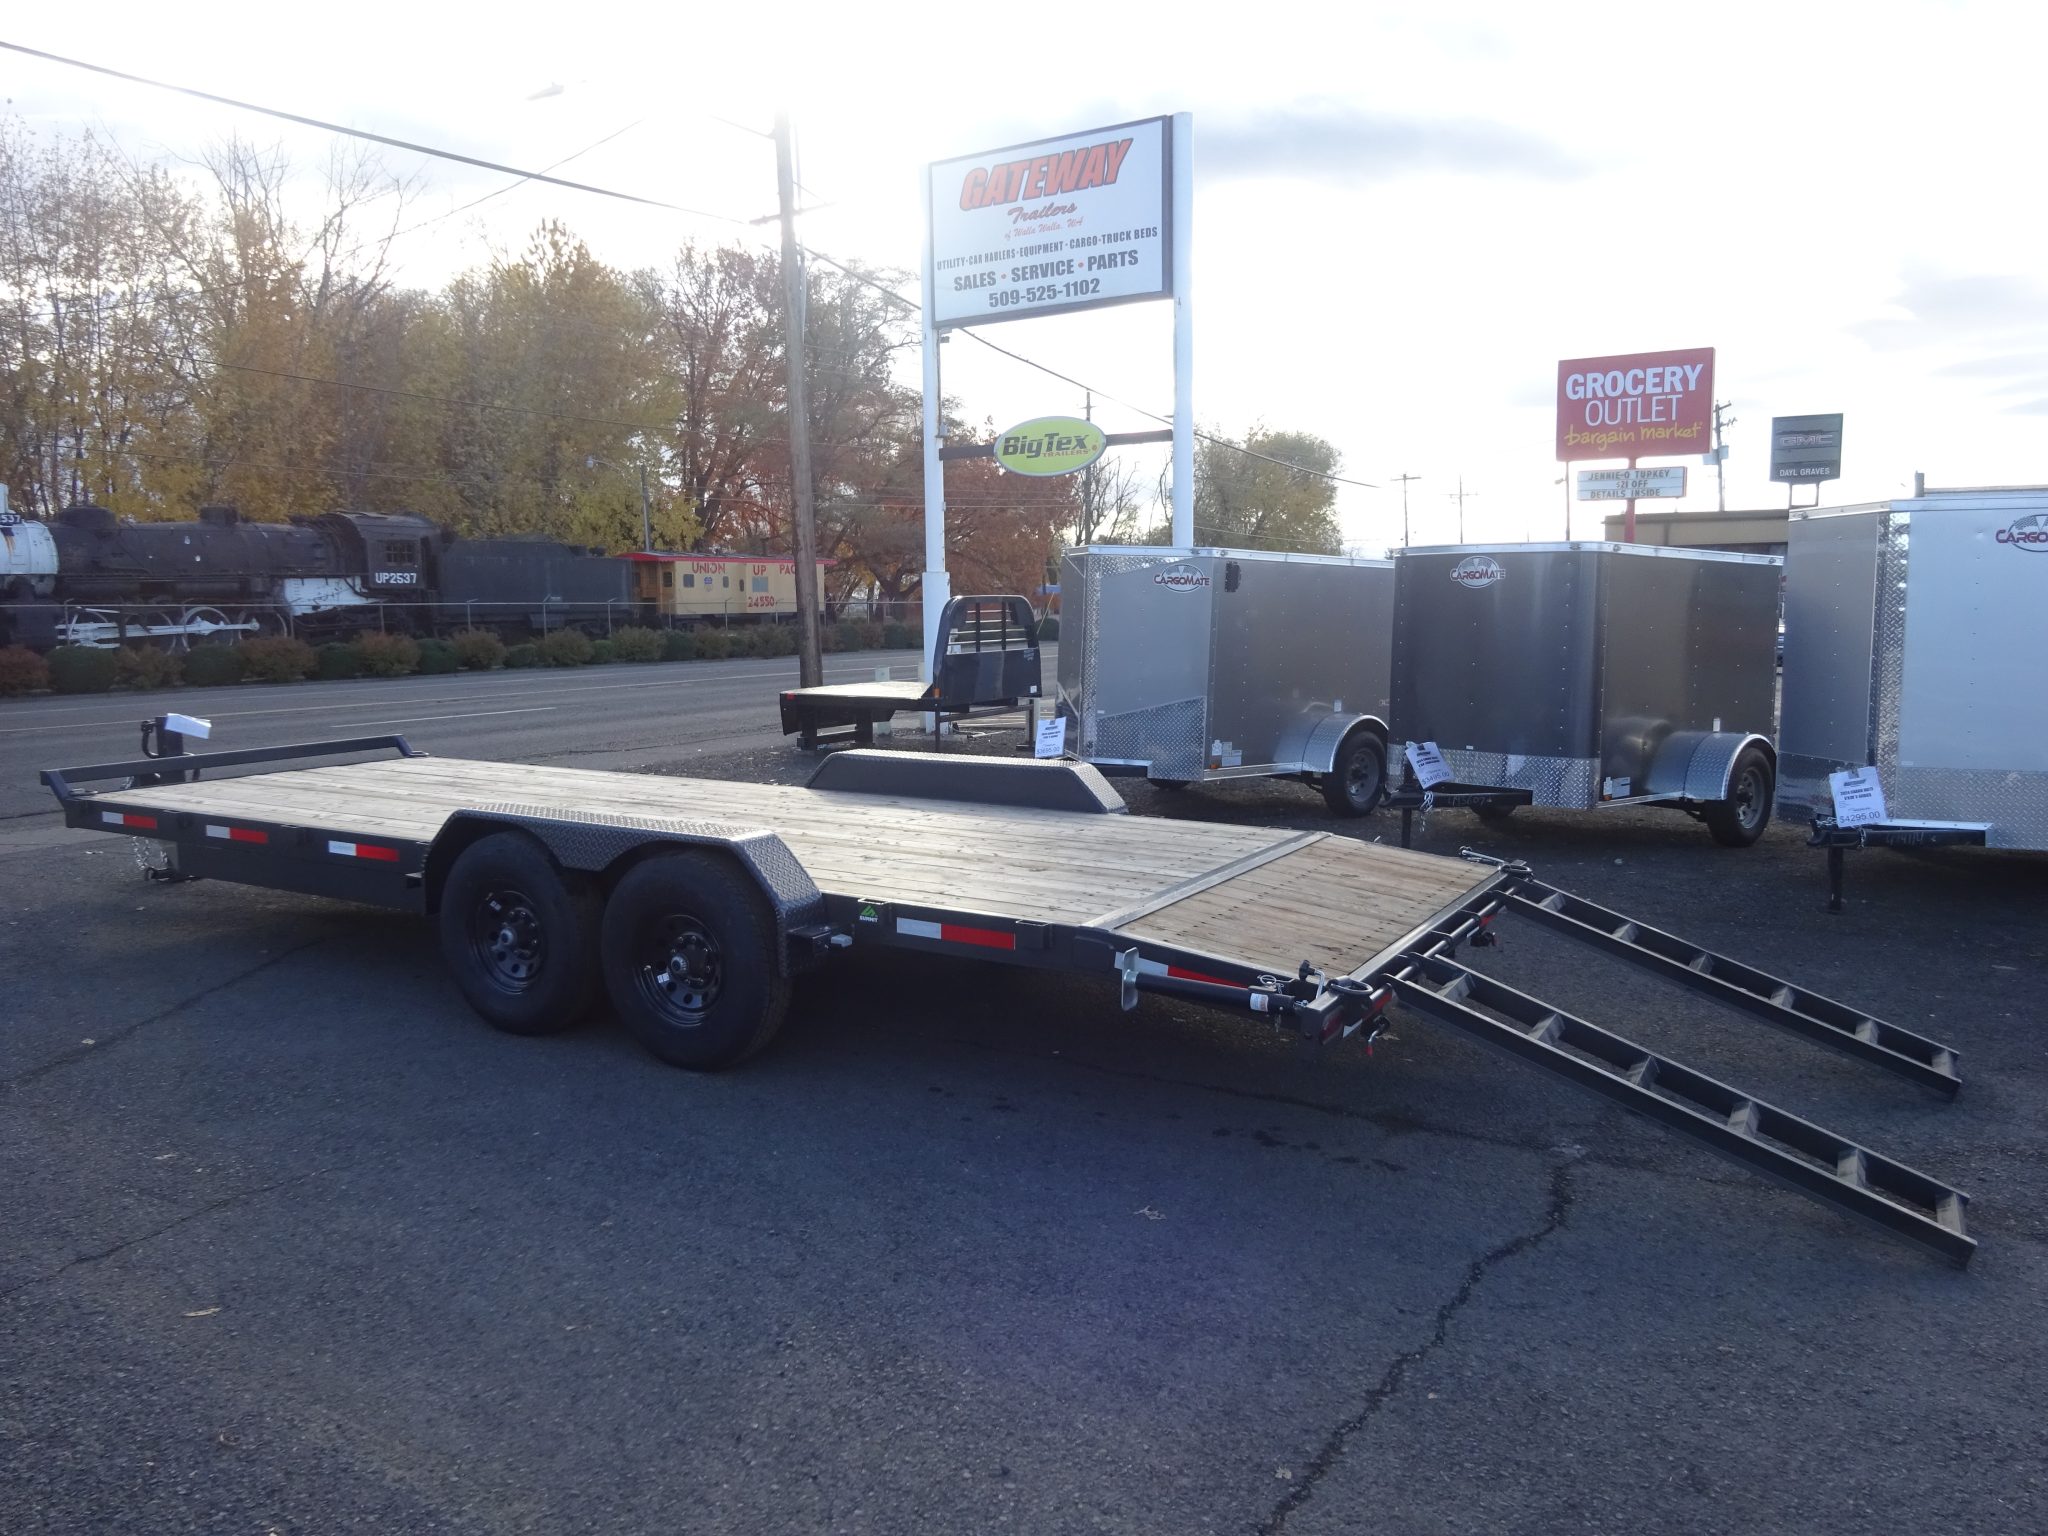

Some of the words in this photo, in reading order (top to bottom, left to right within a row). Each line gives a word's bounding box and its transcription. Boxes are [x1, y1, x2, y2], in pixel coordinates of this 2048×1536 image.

[959, 138, 1134, 211] GATEWAY
[1007, 202, 1077, 224] Trailers
[937, 257, 966, 271] UTILITY
[969, 254, 983, 265] CAR
[984, 248, 1015, 263] HAULERS
[1020, 241, 1063, 257] EQUIPMENT
[1069, 235, 1097, 249] CARGO
[1101, 230, 1131, 244] TRUCK
[1134, 226, 1157, 240] BEDS
[953, 271, 997, 291] SALES
[1011, 259, 1075, 282] SERVICE
[1087, 249, 1139, 271] PARTS
[988, 278, 1100, 307] 509-525-1102
[1565, 363, 1704, 400] GROCERY
[1585, 394, 1682, 427] OUTLET
[1564, 424, 1635, 451] bargain
[1640, 421, 1702, 441] market
[1780, 434, 1833, 446] GMC
[1043, 449, 1089, 458] TRAILERS
[1589, 471, 1630, 481] JENNIE-O
[1780, 469, 1798, 477] DAYL
[1800, 467, 1830, 476] GRAVES
[1631, 479, 1648, 488] OFF
[1590, 490, 1626, 499] DETAILS
[1631, 488, 1660, 497] INSIDE
[692, 562, 726, 574] UNION
[753, 564, 767, 575] UP
[375, 572, 417, 584] UP2537
